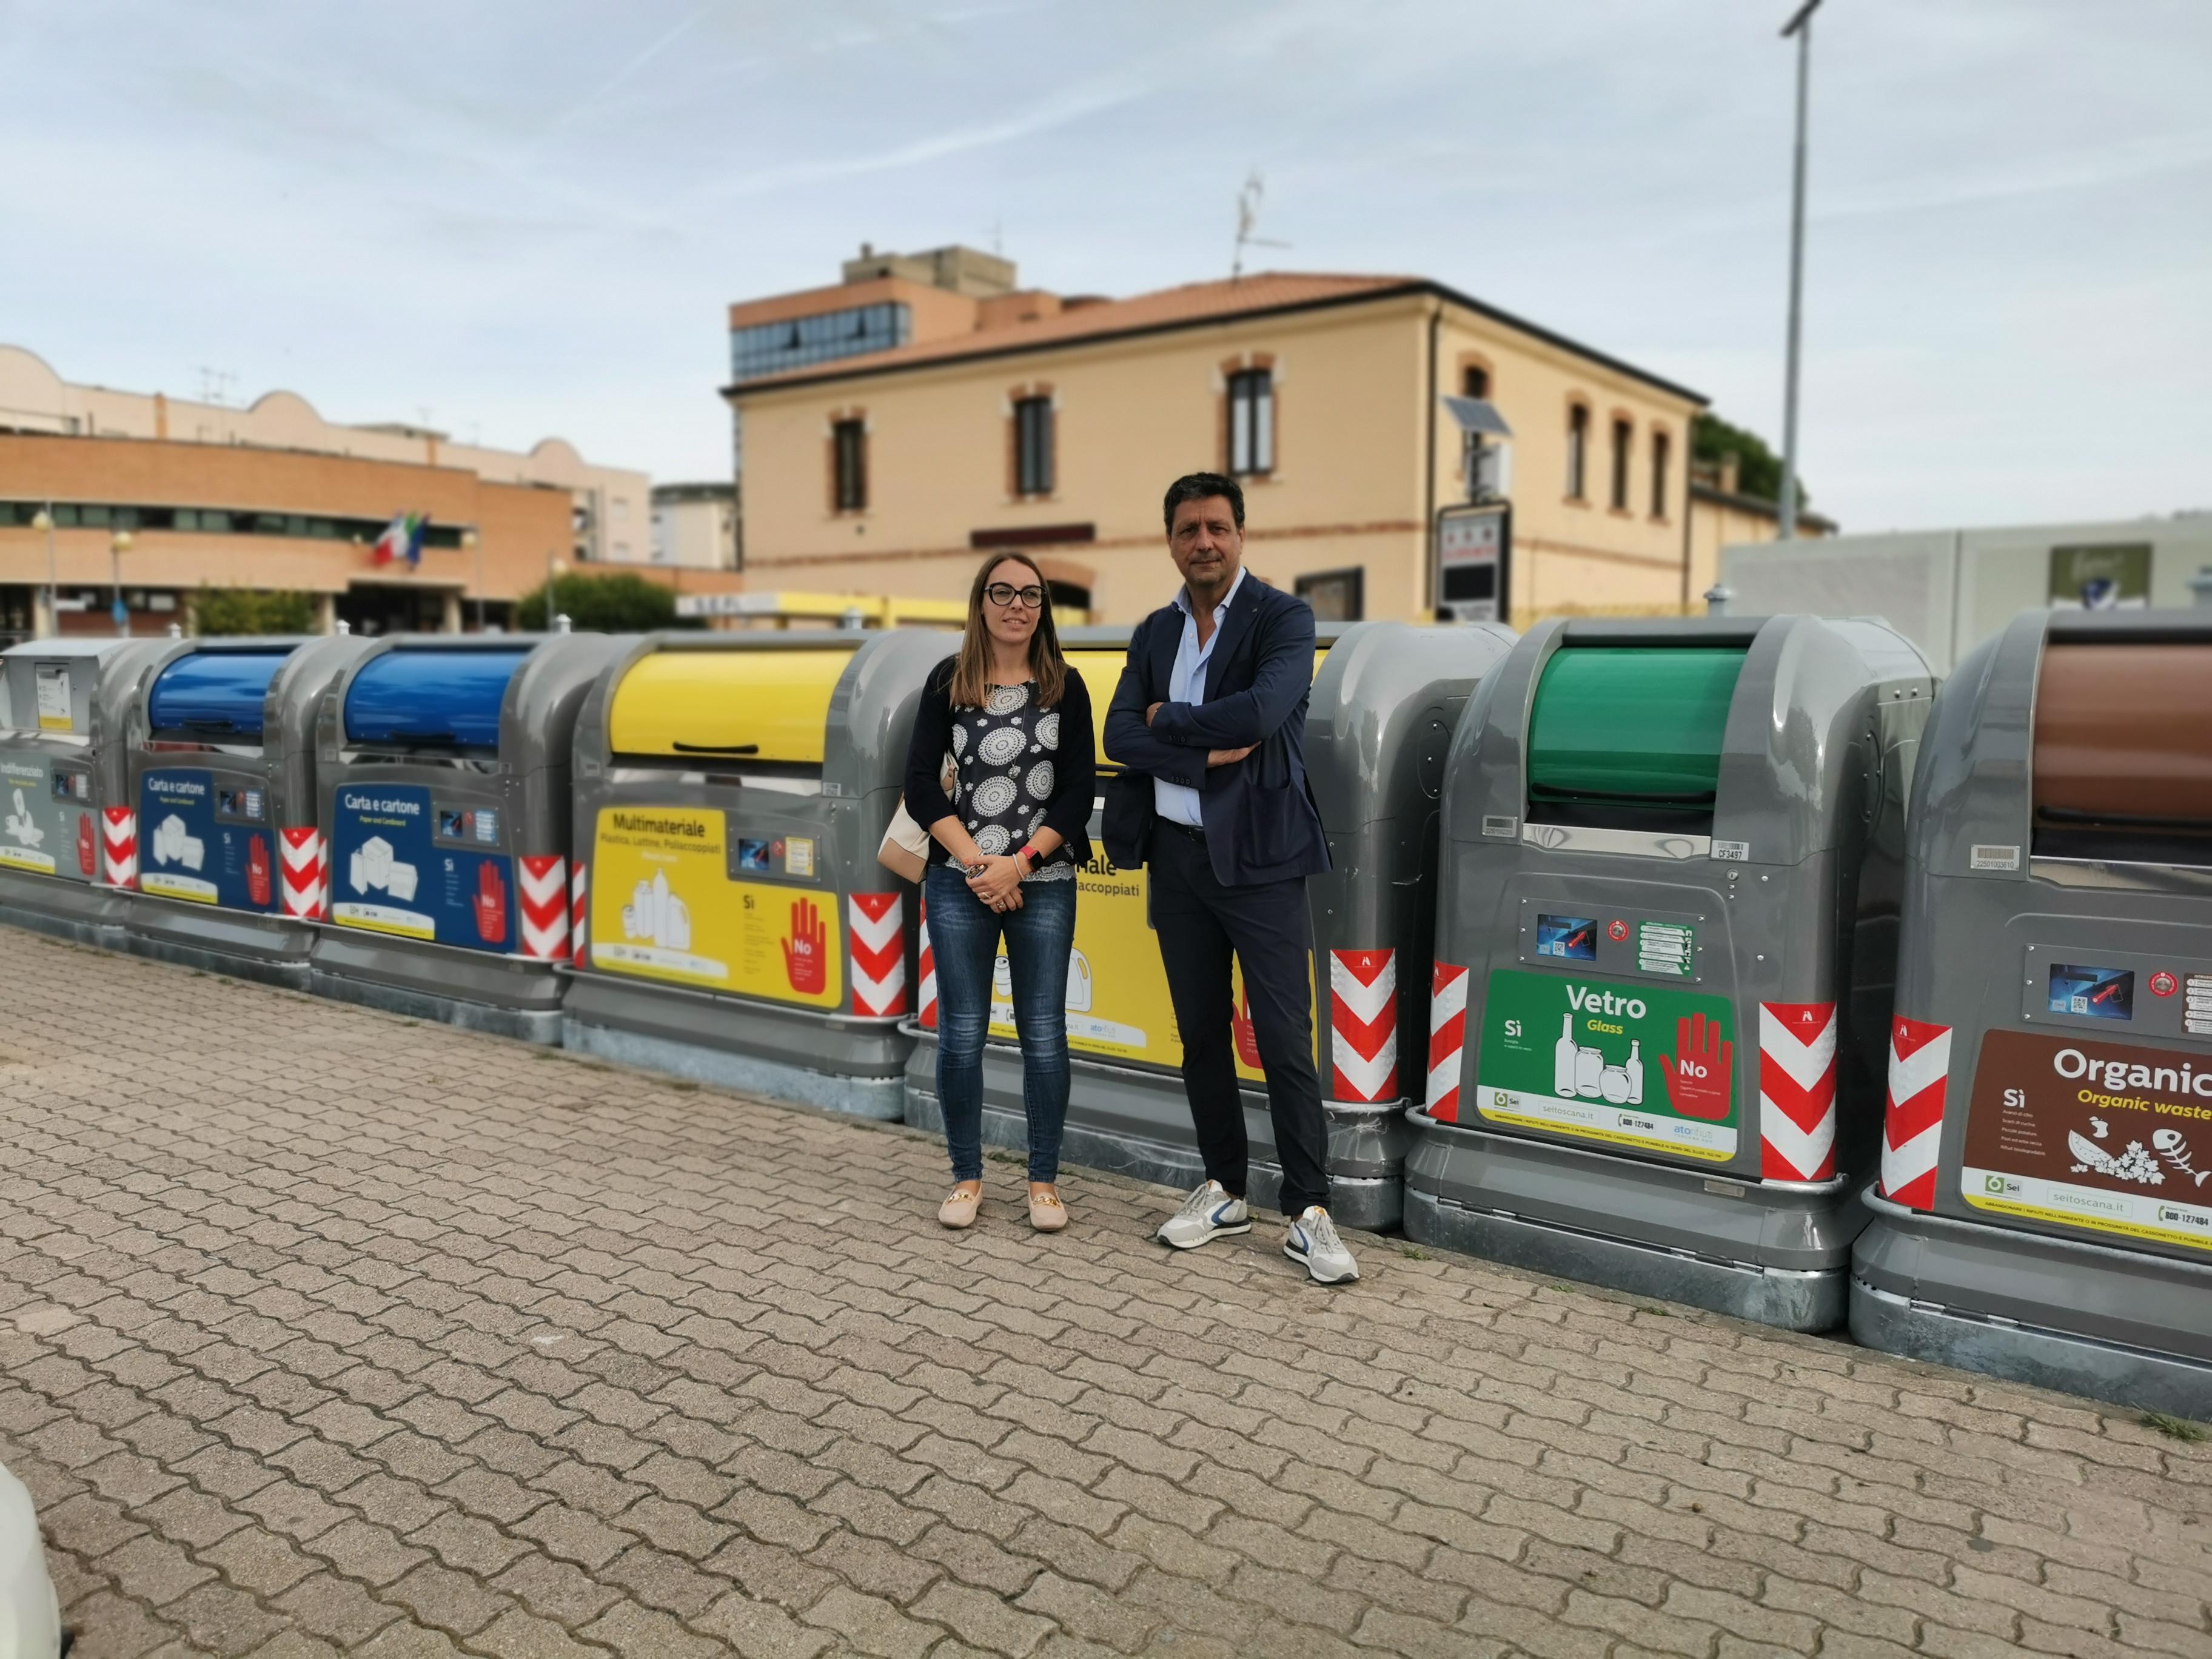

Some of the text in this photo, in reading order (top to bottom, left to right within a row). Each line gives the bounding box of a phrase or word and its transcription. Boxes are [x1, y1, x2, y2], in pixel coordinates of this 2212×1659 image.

[149, 777, 205, 795] Carta e cartone
[345, 794, 420, 815] Carta e cartone
[613, 813, 705, 837] Multimateriale
[664, 839, 722, 854] Poliaccoppiati
[1719, 850, 1742, 859] CF3497
[252, 863, 263, 875] No
[1078, 882, 1140, 897] accoppiati
[481, 895, 495, 908] No
[743, 895, 754, 910] Sì
[794, 939, 812, 955] No
[1566, 984, 1646, 1019] Vetro
[1504, 1020, 1521, 1037] Sì
[1587, 1019, 1623, 1034] Glass
[1680, 1059, 1708, 1078] No
[2003, 1088, 2025, 1108] Sì
[2077, 1090, 2212, 1120] Organic waste
[1543, 1105, 1594, 1120] seitoscana.it
[2006, 1183, 2020, 1192] Sei
[2053, 1193, 2124, 1212] seitoscana.it
[2165, 1211, 2208, 1226] 800-127484
